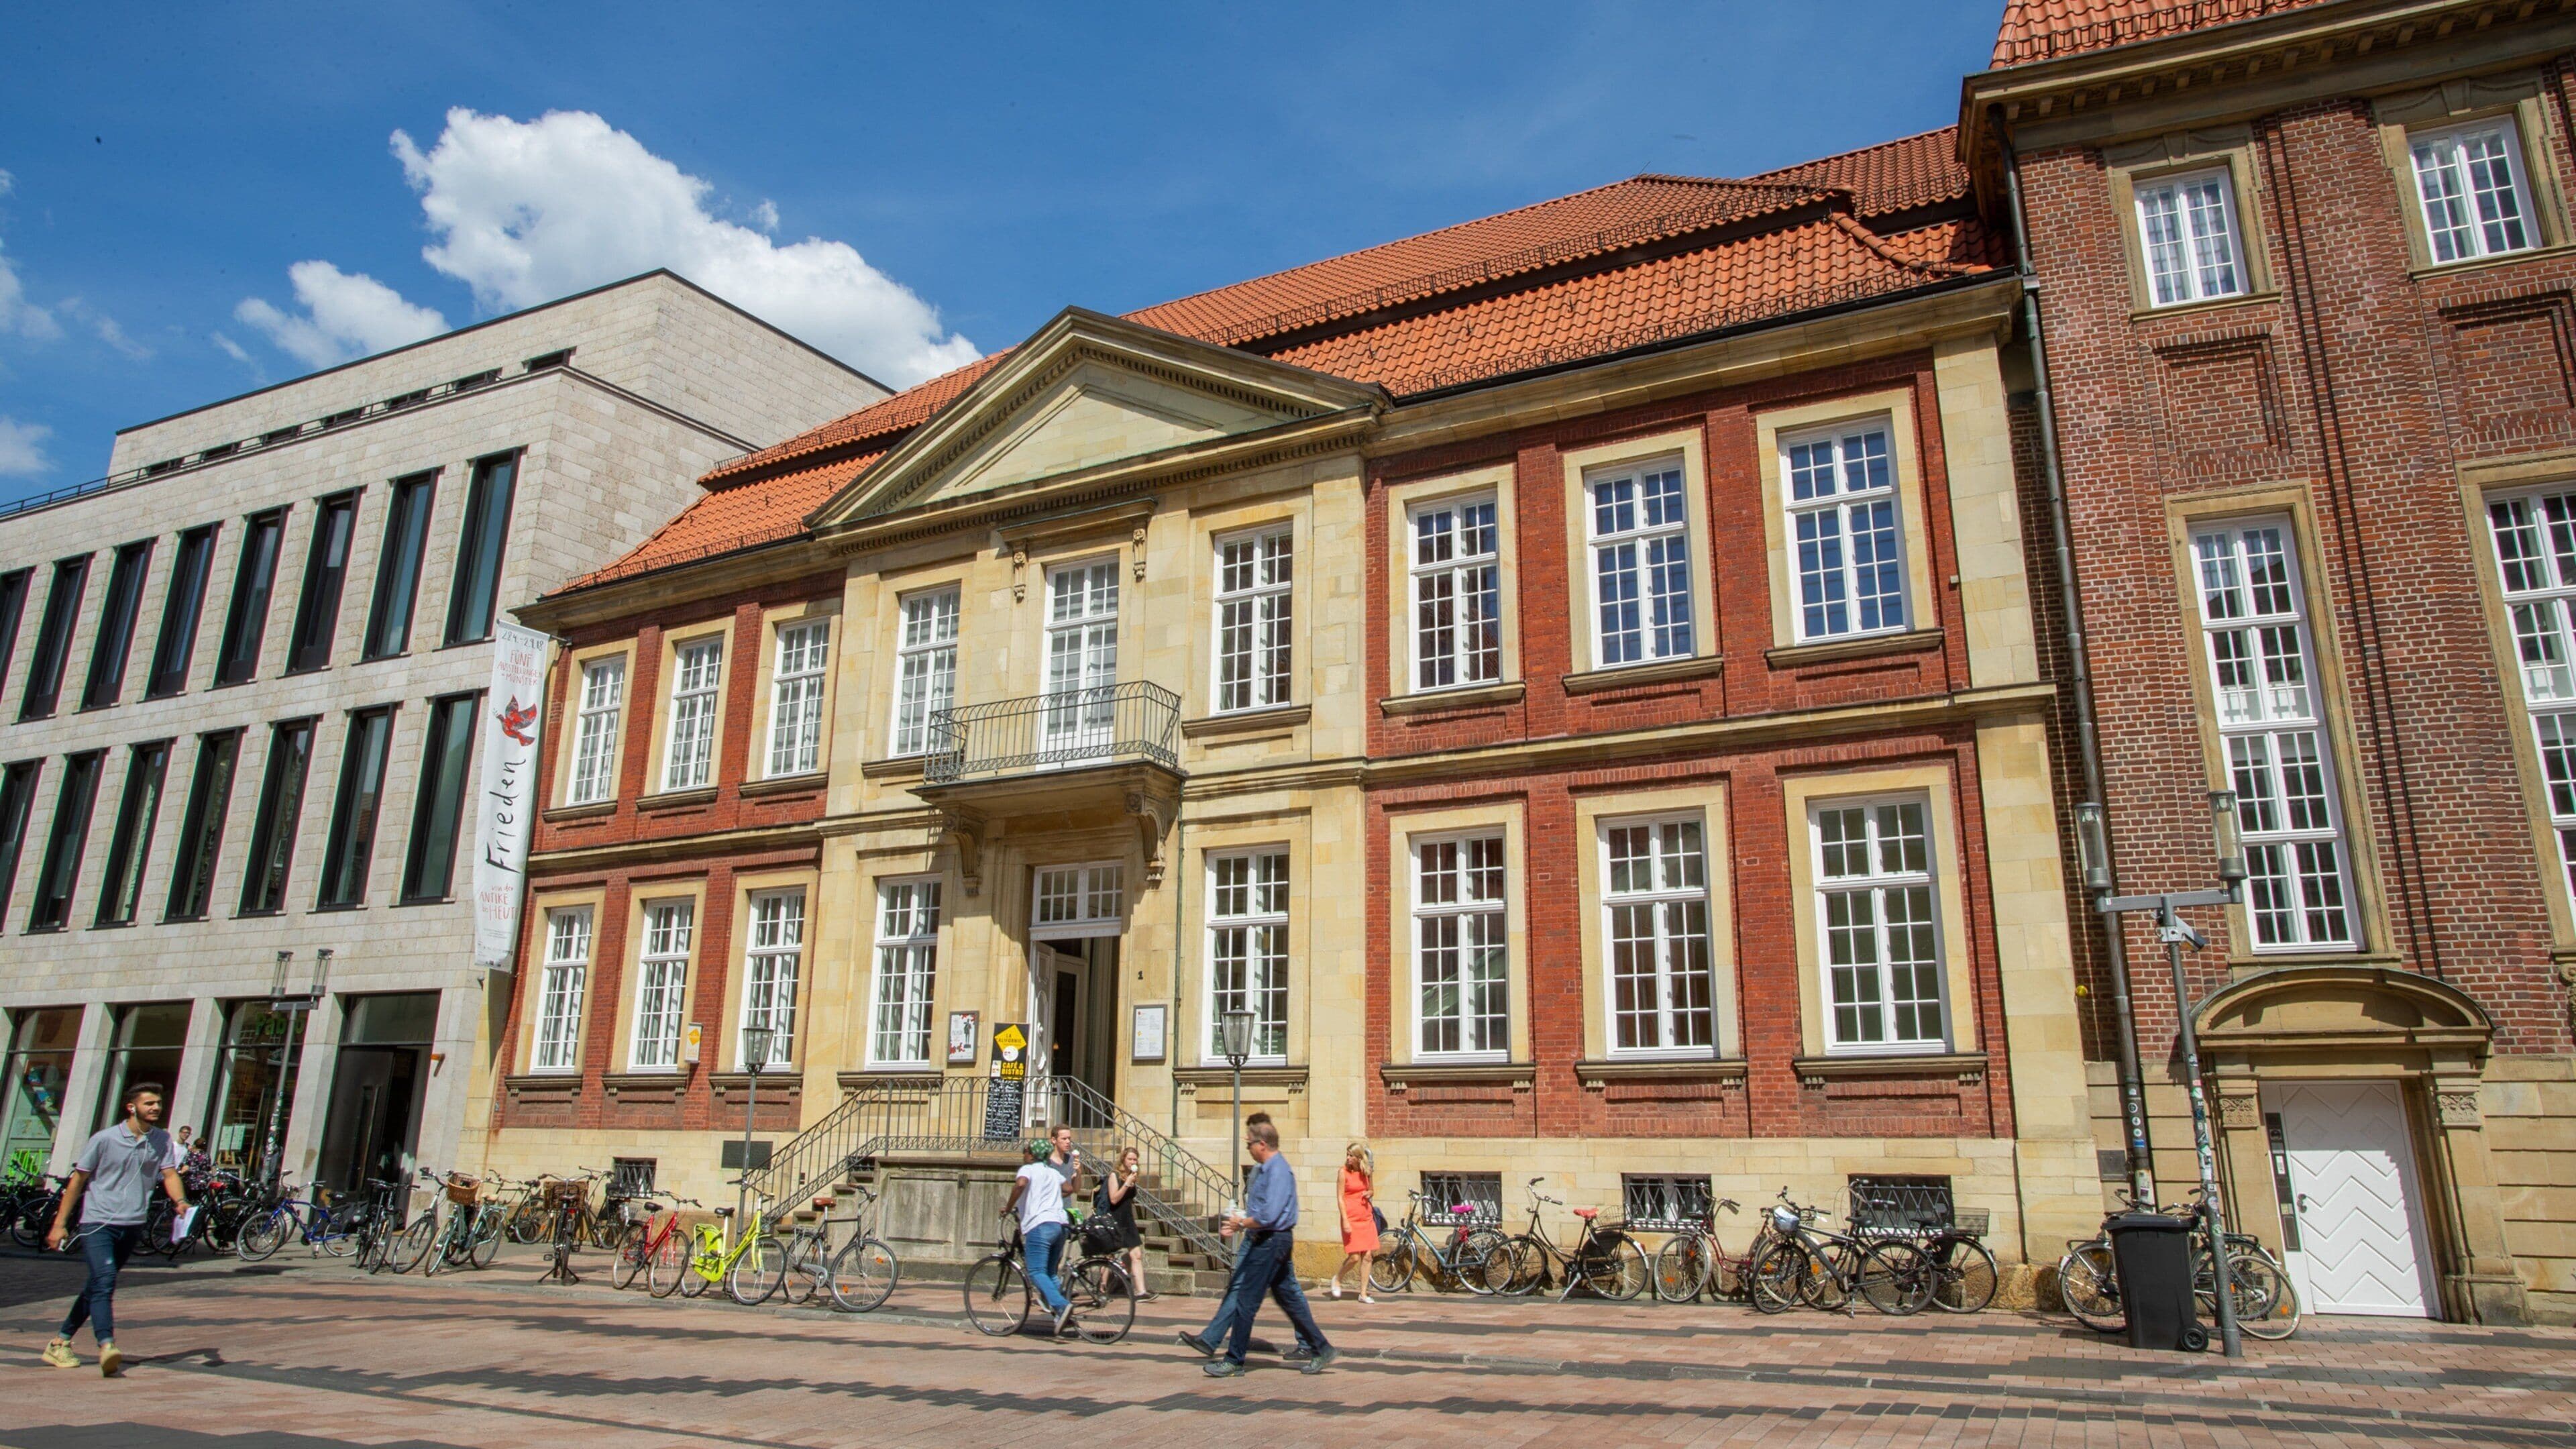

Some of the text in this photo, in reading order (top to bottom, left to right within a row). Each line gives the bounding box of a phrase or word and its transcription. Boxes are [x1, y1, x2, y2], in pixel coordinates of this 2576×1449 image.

[510, 649, 533, 668] FÜNF
[486, 759, 526, 873] Frieden
[480, 891, 508, 905] ANTIKE
[255, 1011, 305, 1036] Pabo
